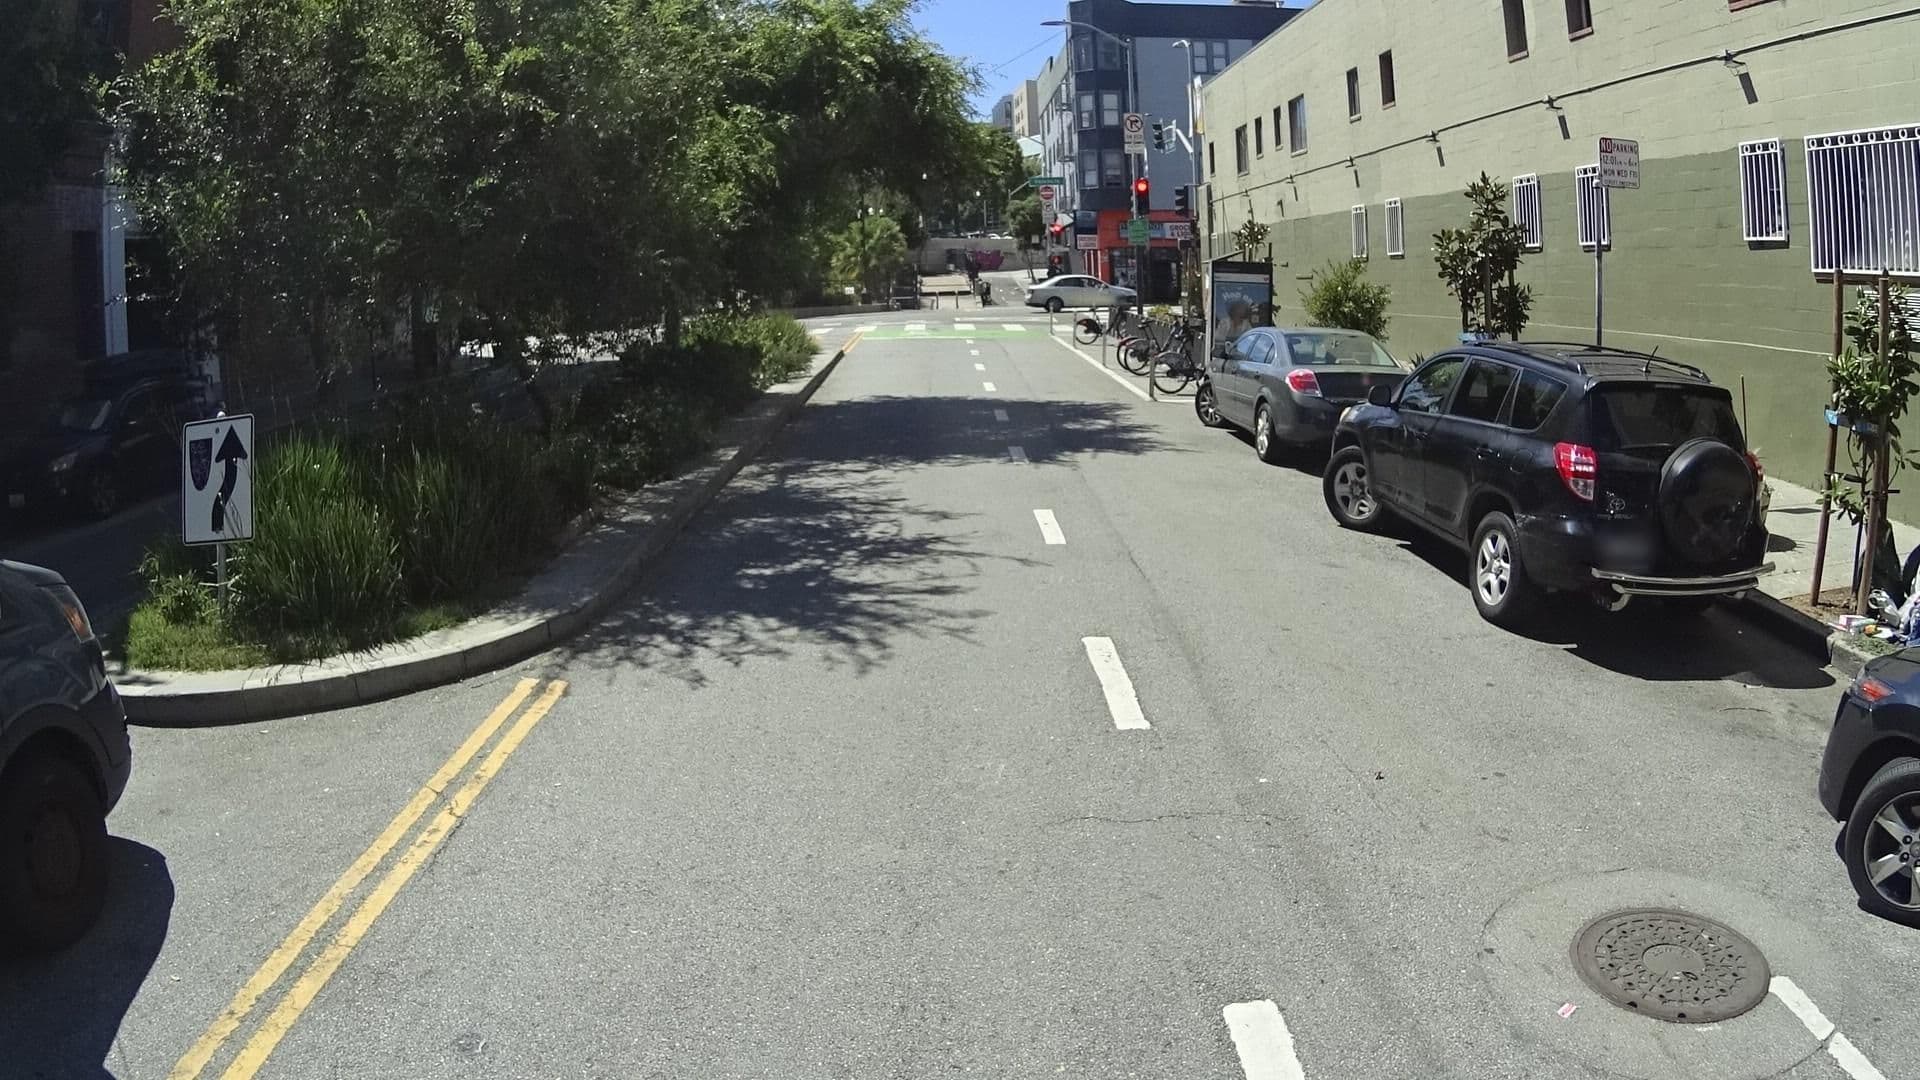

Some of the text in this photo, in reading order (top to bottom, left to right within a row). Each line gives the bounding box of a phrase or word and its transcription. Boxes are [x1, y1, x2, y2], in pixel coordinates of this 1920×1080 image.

[1601, 139, 1638, 154] NO PARKING
[1603, 168, 1638, 178] MON WED FRI
